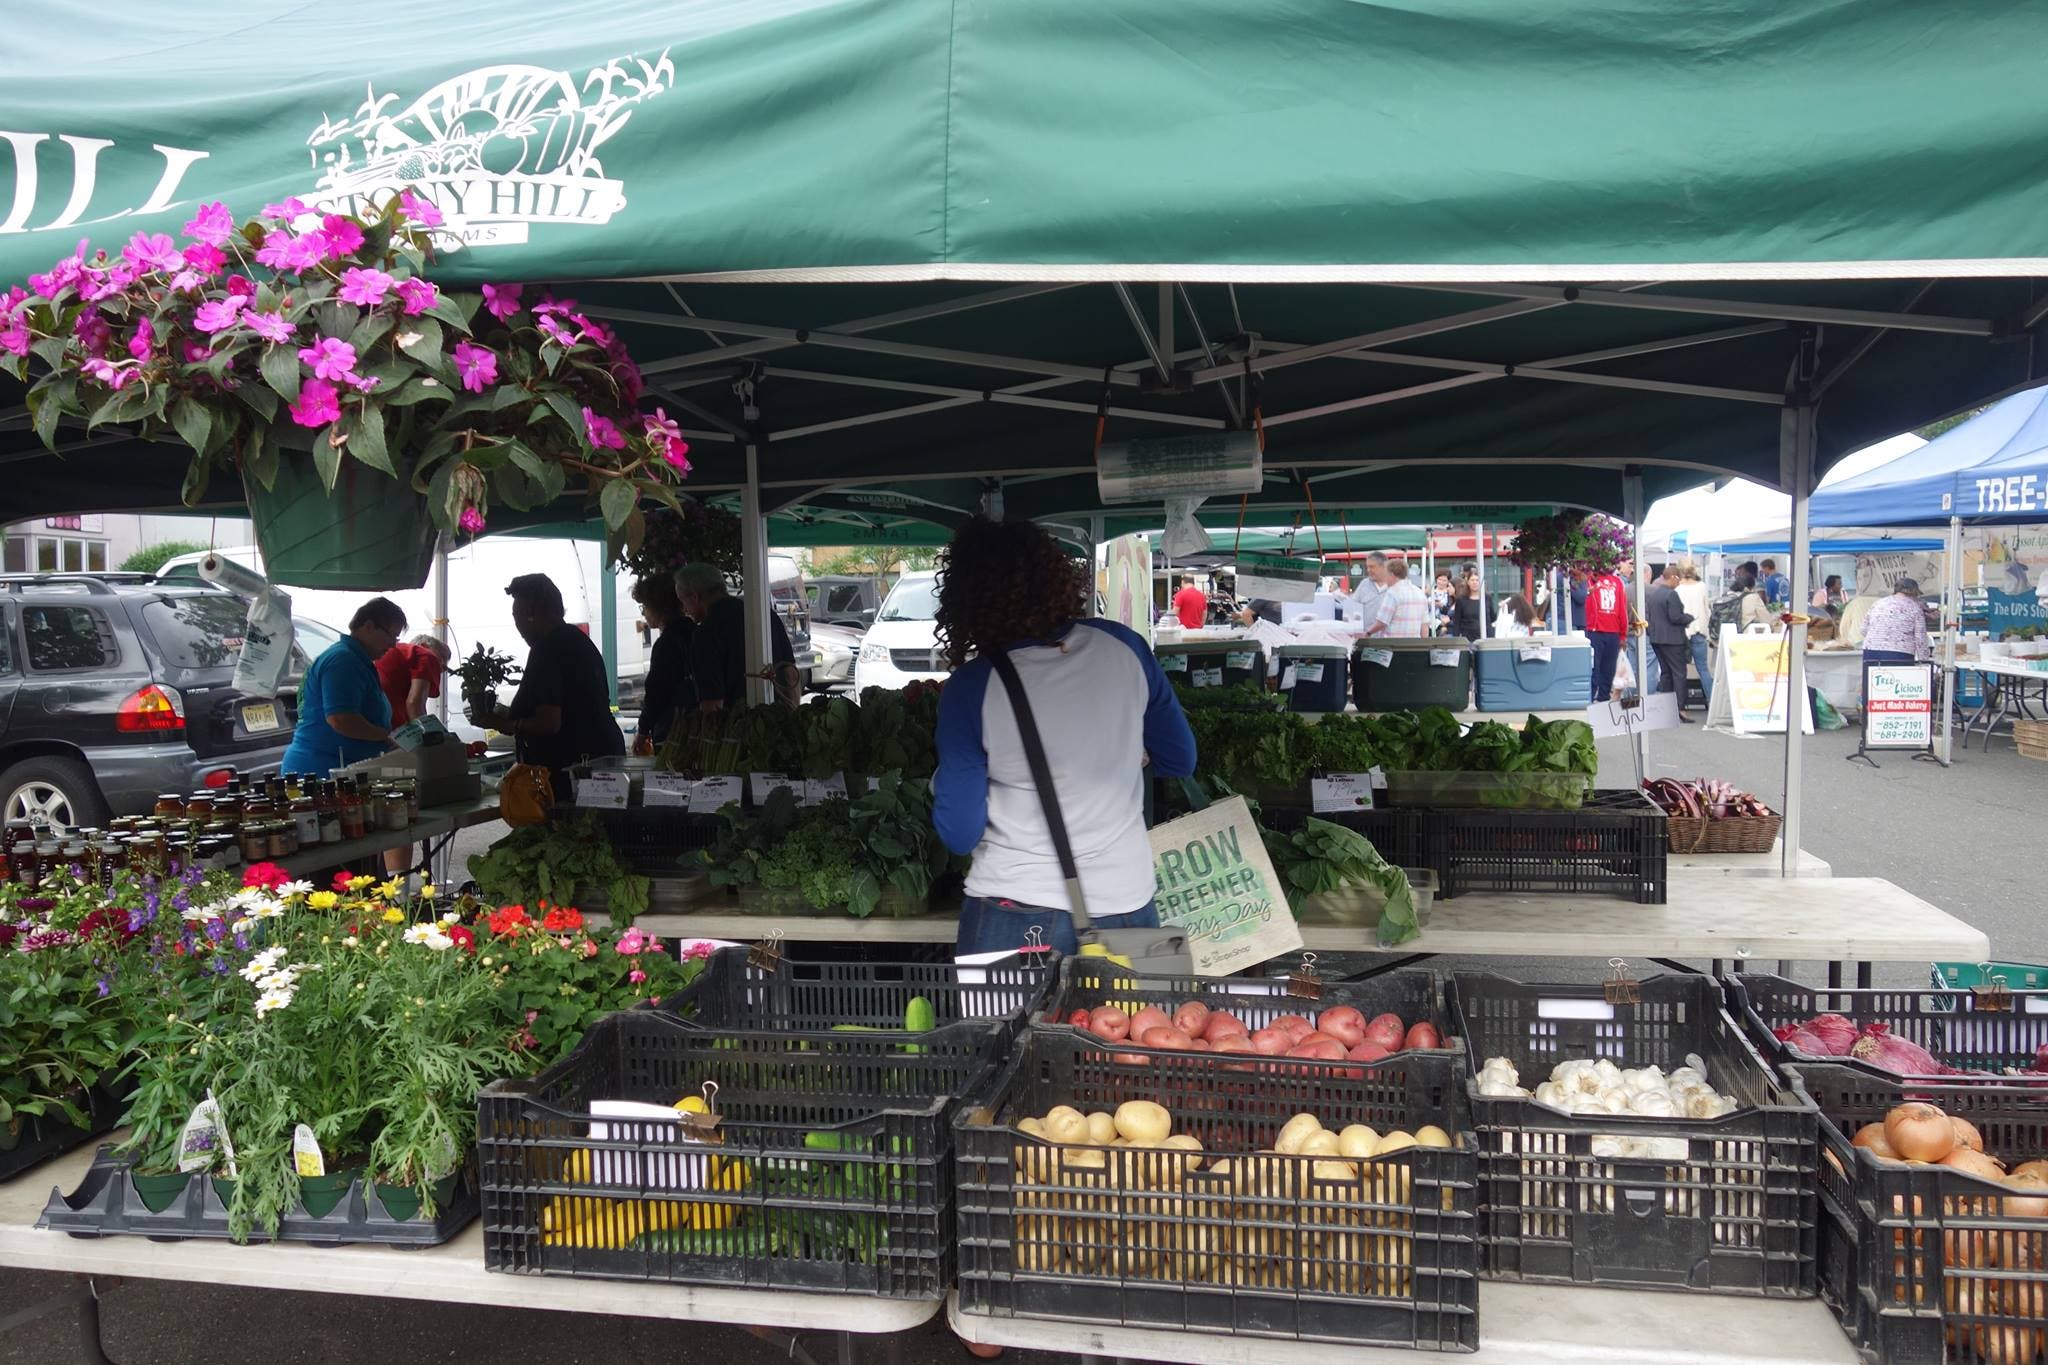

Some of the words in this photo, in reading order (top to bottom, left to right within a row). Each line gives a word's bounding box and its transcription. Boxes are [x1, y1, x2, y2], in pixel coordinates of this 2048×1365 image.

[486, 179, 598, 219] HILL
[1994, 602, 2009, 615] The
[2011, 603, 2029, 617] UPS
[1894, 683, 1923, 694] Licious
[1871, 702, 1886, 710] Just
[1887, 702, 1904, 710] Made
[1905, 702, 1928, 711] Bakery
[1882, 721, 1922, 730] 852-7191
[1880, 731, 1924, 739] 689-2906
[1155, 867, 1261, 923] GREENER
[1220, 898, 1273, 923] Day
